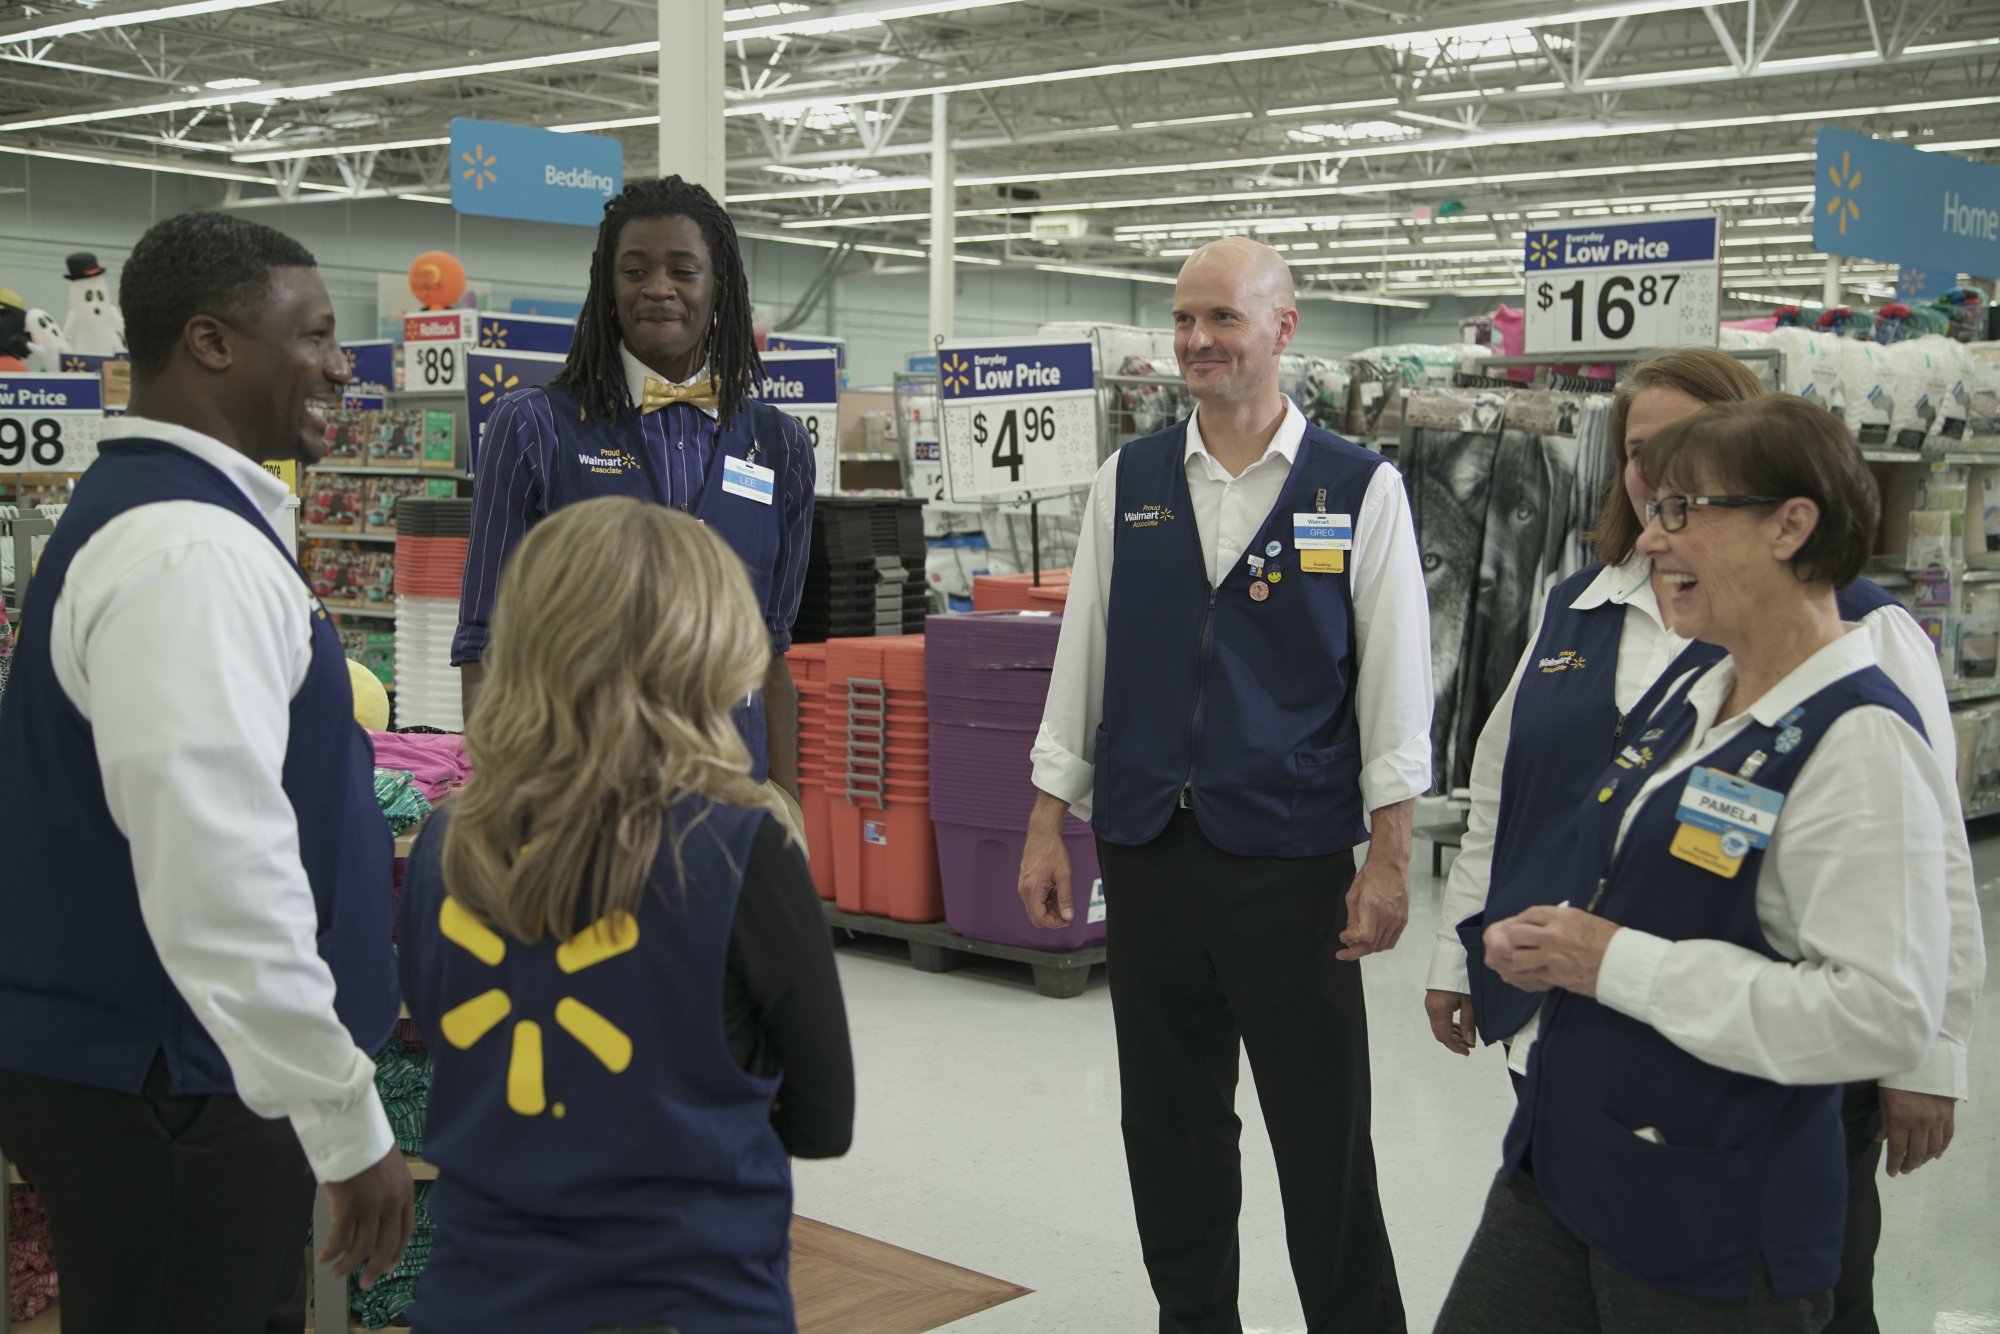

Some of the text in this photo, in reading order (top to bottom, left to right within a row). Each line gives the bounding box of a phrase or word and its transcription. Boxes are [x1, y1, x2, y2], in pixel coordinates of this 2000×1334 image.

[545, 164, 613, 196] Bedding
[1943, 190, 1999, 241] Home
[1566, 232, 1605, 243] Everyday
[1565, 237, 1670, 264] Low Price
[419, 321, 457, 337] Rollback
[974, 354, 1007, 366] Everyday
[974, 361, 1060, 391] Low Price
[763, 376, 804, 399] Price
[18, 389, 67, 406] Price
[0, 418, 64, 466] 98
[578, 453, 622, 467] Walmart
[600, 448, 620, 457] Proud
[591, 465, 622, 474] Associate
[739, 475, 756, 488] LEE
[1124, 510, 1159, 522] Walmart
[1310, 528, 1335, 537] GREG
[1699, 796, 1758, 825] PAMELA
